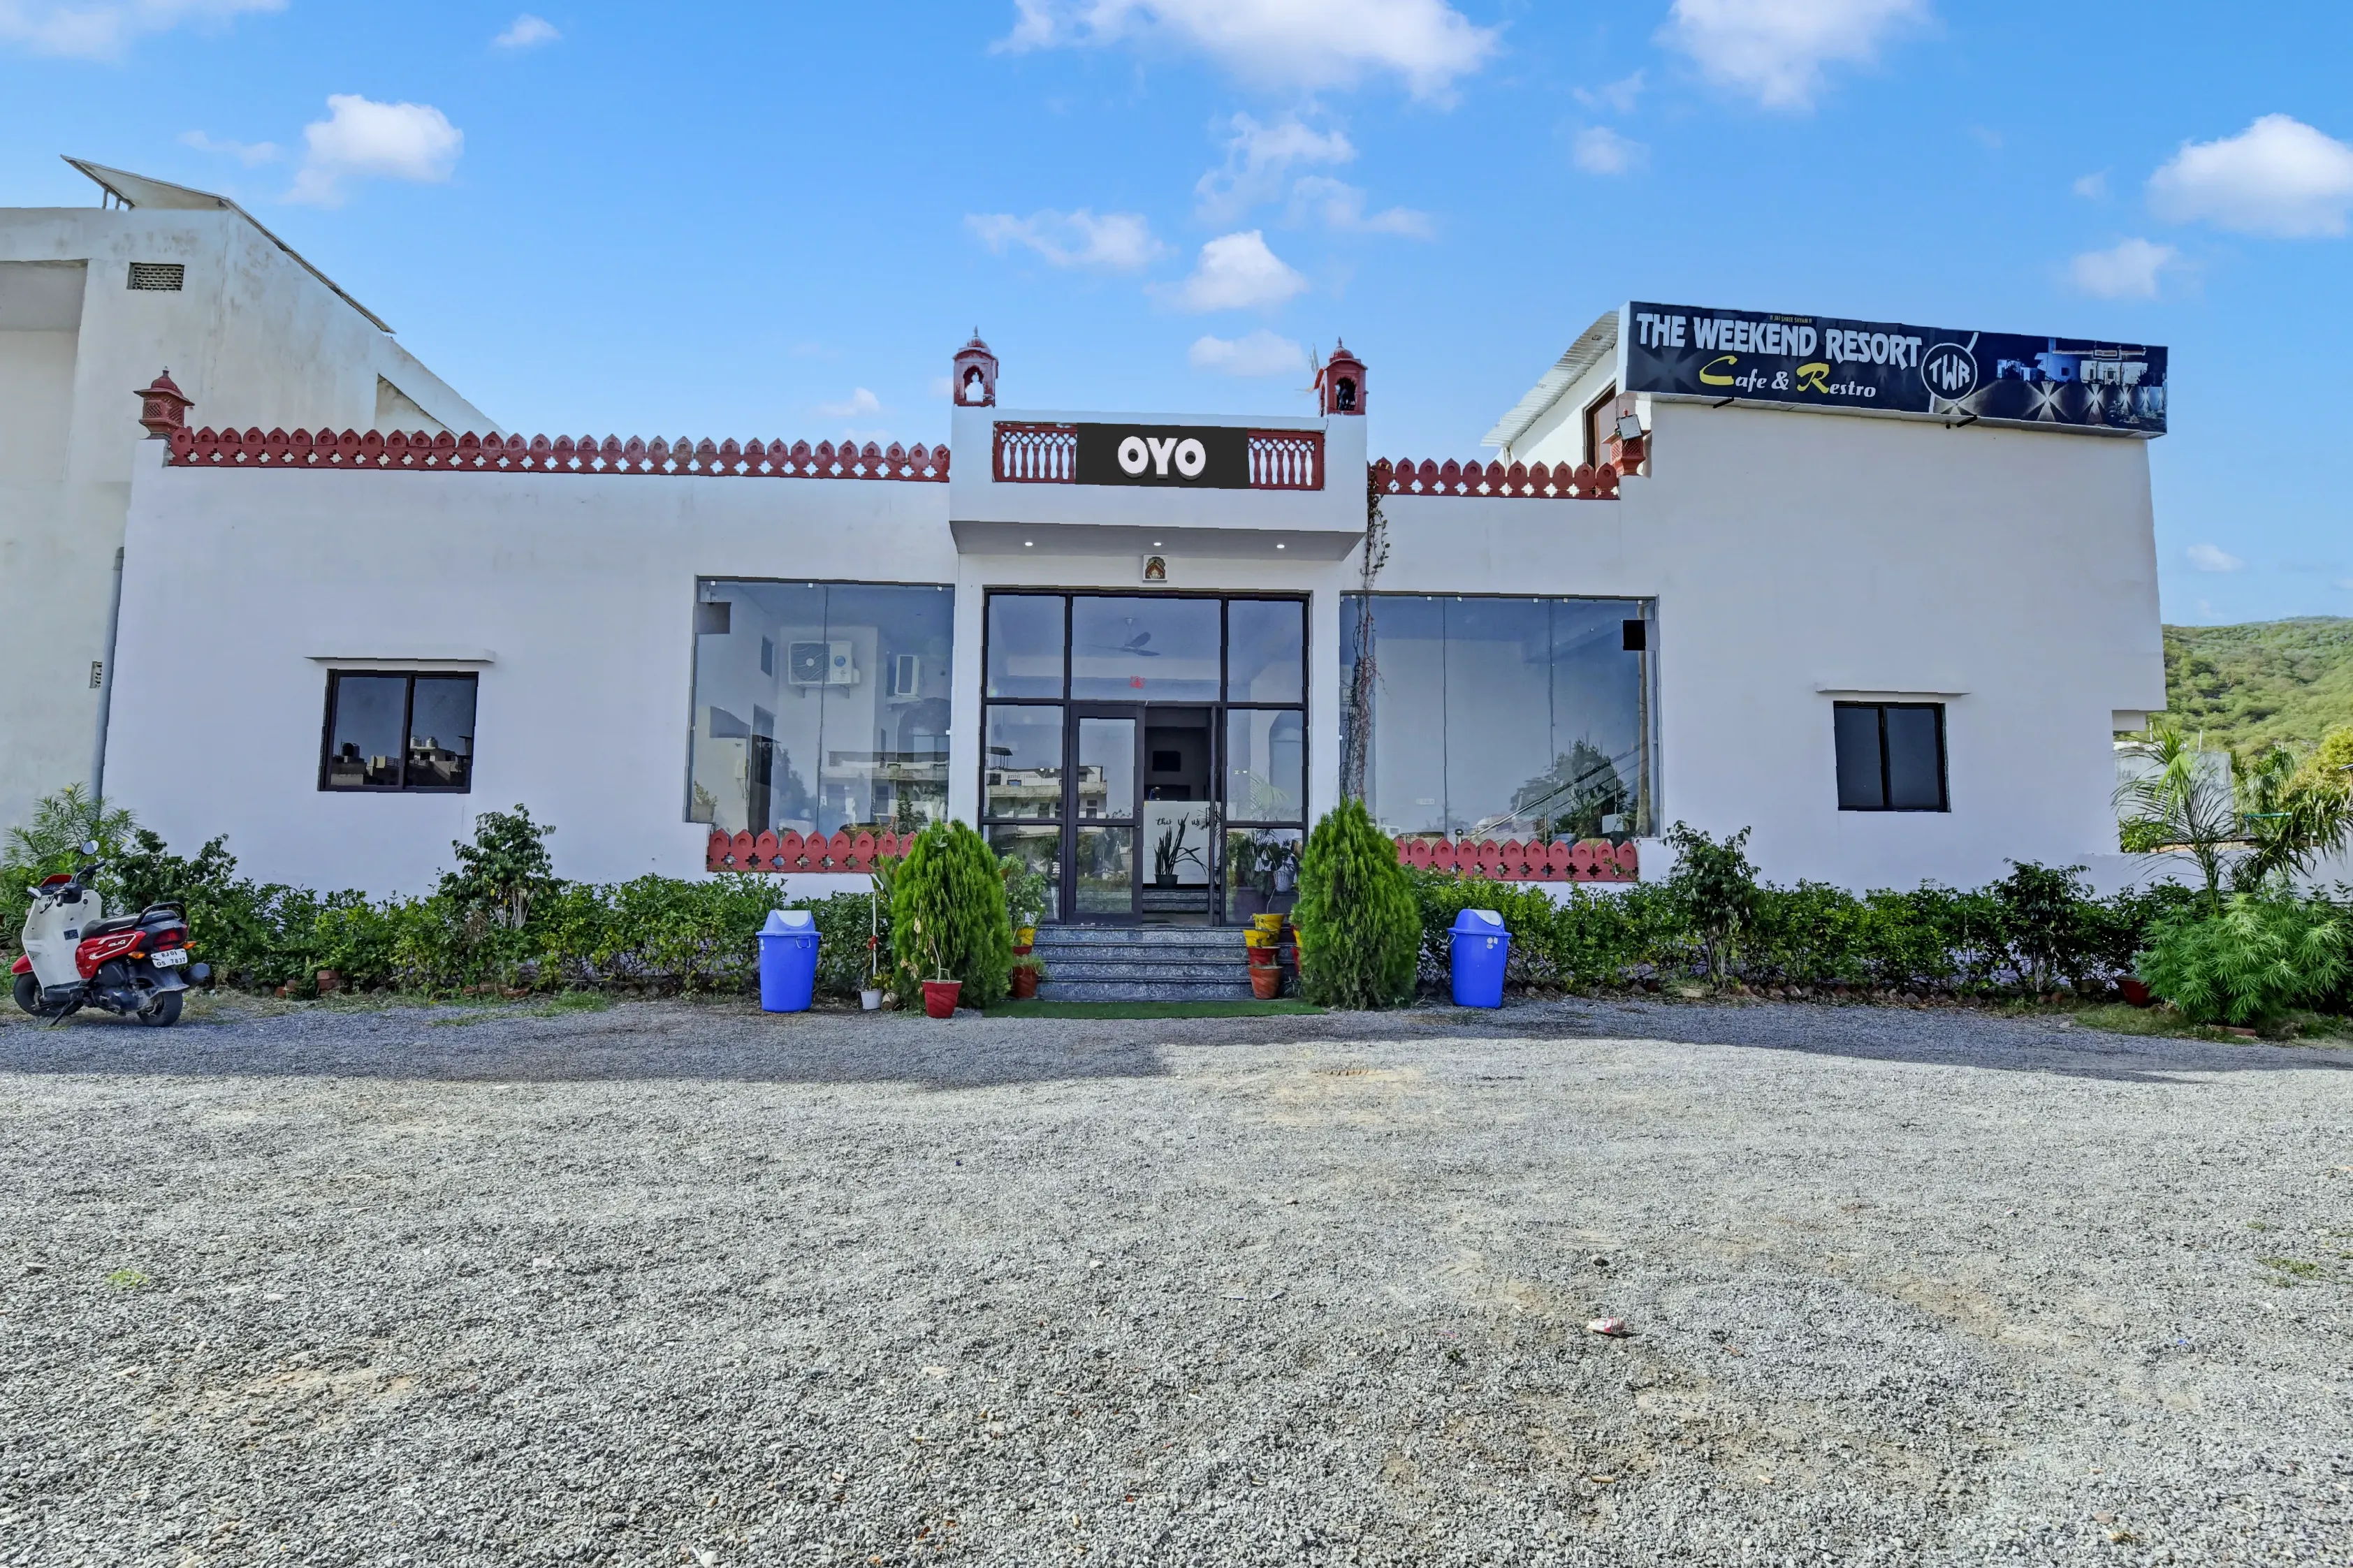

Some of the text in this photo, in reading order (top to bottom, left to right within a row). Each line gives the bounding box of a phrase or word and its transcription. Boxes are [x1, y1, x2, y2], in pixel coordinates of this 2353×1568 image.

[1636, 313, 1922, 370] THE WEEKEND RESORT
[1699, 356, 1877, 397] Cafe & Restro
[1929, 354, 1970, 390] TWR
[1118, 436, 1207, 480] OYO
[1156, 817, 1172, 826] this
